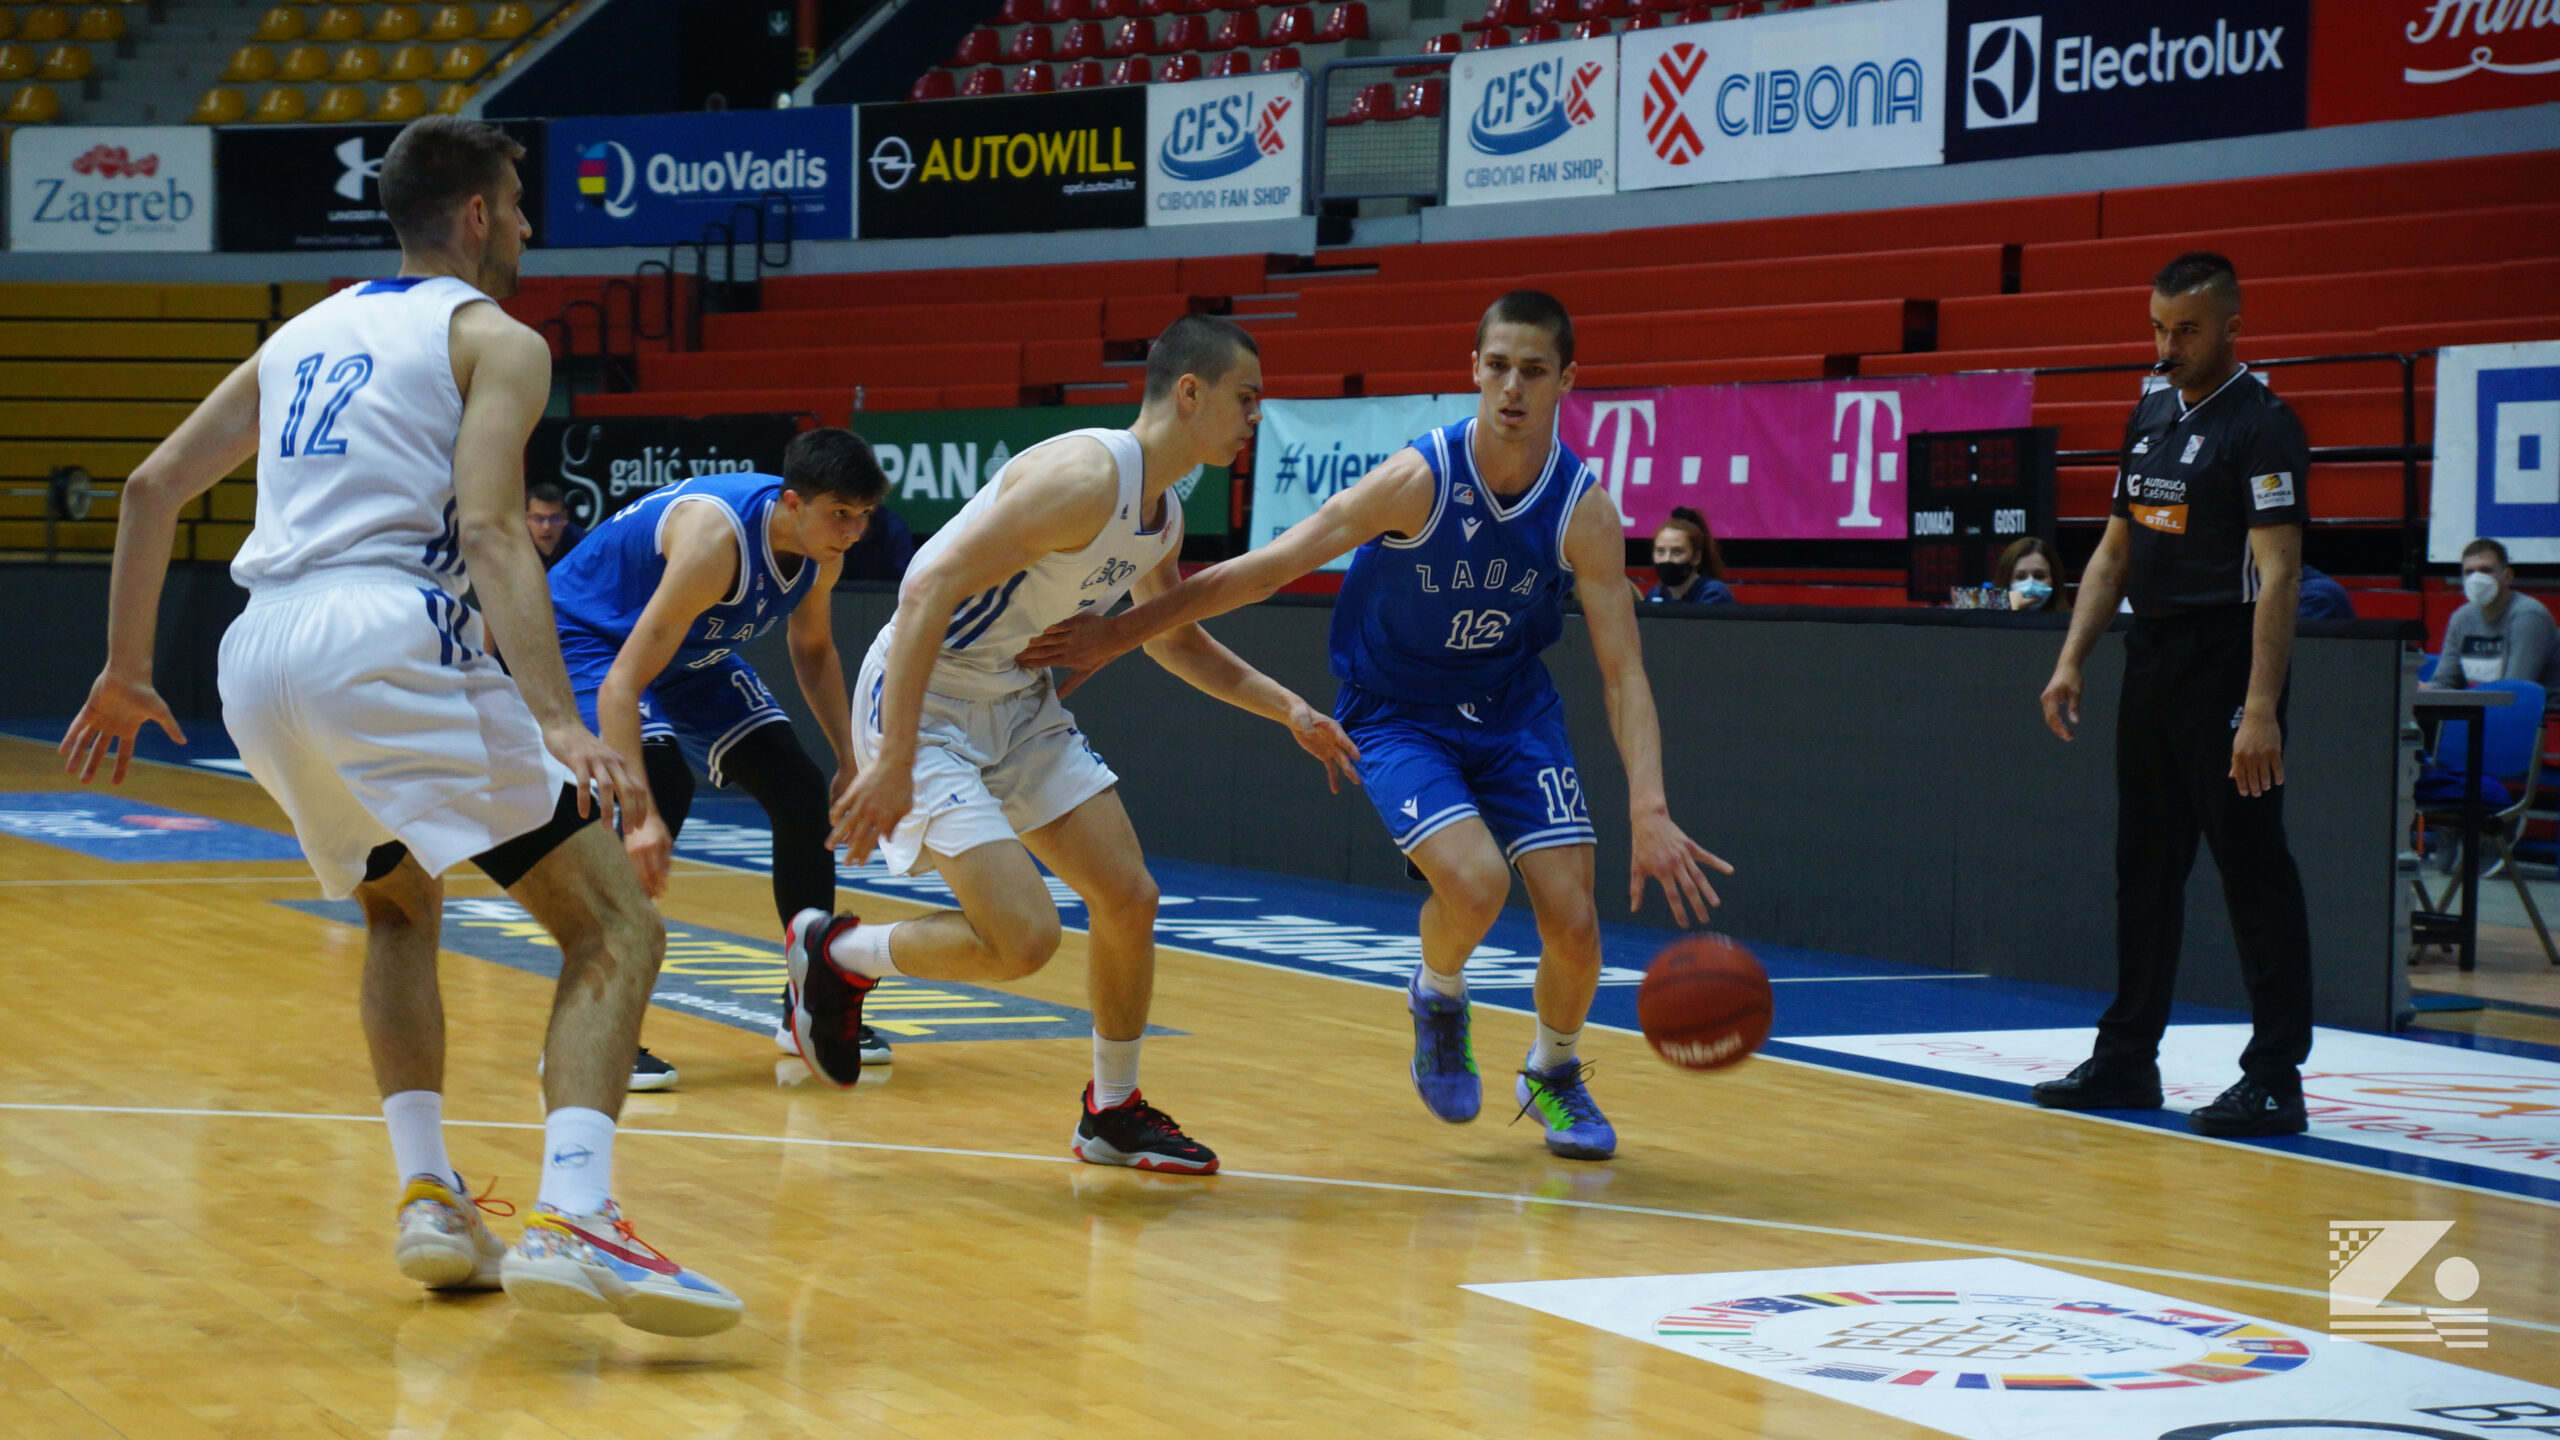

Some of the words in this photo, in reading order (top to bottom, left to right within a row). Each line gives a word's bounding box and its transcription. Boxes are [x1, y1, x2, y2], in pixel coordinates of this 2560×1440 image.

[2054, 19, 2284, 93] Electrolux
[1716, 58, 1923, 138] CIBONA
[646, 149, 828, 195] QuoVadis
[920, 126, 1136, 183] AUTOWILL
[1465, 164, 1525, 188] CIBONA
[1530, 162, 1557, 184] FAN
[1562, 158, 1603, 181] SHOP
[34, 177, 193, 234] Zagreb
[1157, 190, 1216, 211] CIBONA
[1221, 188, 1248, 208] FAN
[1253, 186, 1291, 206] SHOP
[280, 352, 374, 457] 12
[608, 446, 682, 497] galić
[1994, 509, 2026, 533] GOSTI
[2145, 515, 2182, 529] STILL
[1445, 609, 1511, 650] 12
[1537, 767, 1592, 825] 12
[1696, 1338, 1809, 1364] 2021
